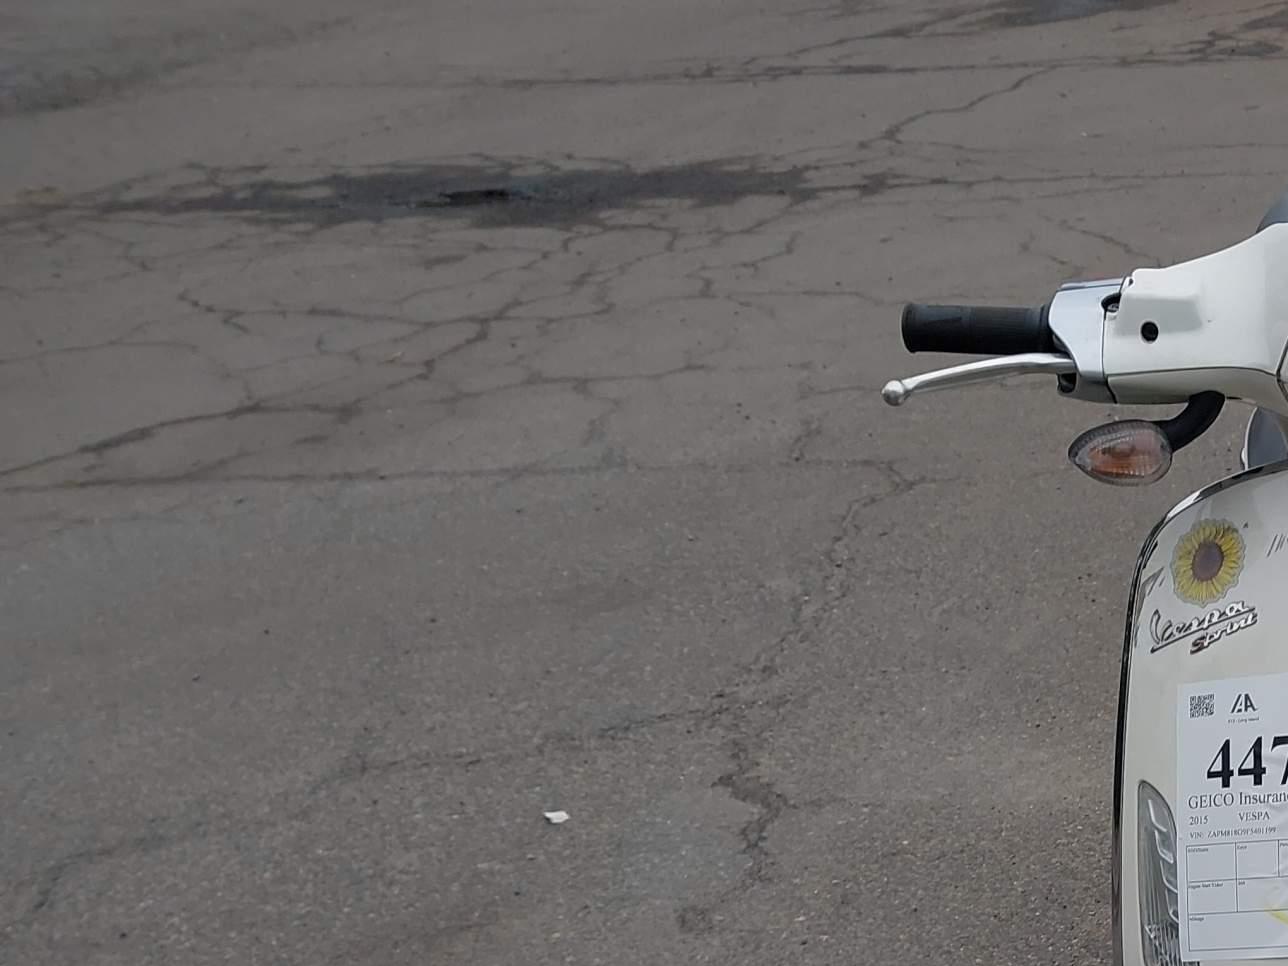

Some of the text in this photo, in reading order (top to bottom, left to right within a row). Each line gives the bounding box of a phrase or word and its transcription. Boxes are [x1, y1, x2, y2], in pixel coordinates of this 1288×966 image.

[1150, 600, 1254, 648] Vespa
[1188, 793, 1234, 809] GEICO
[1189, 815, 1208, 826] 2015
[1238, 810, 1270, 822] VESPA
